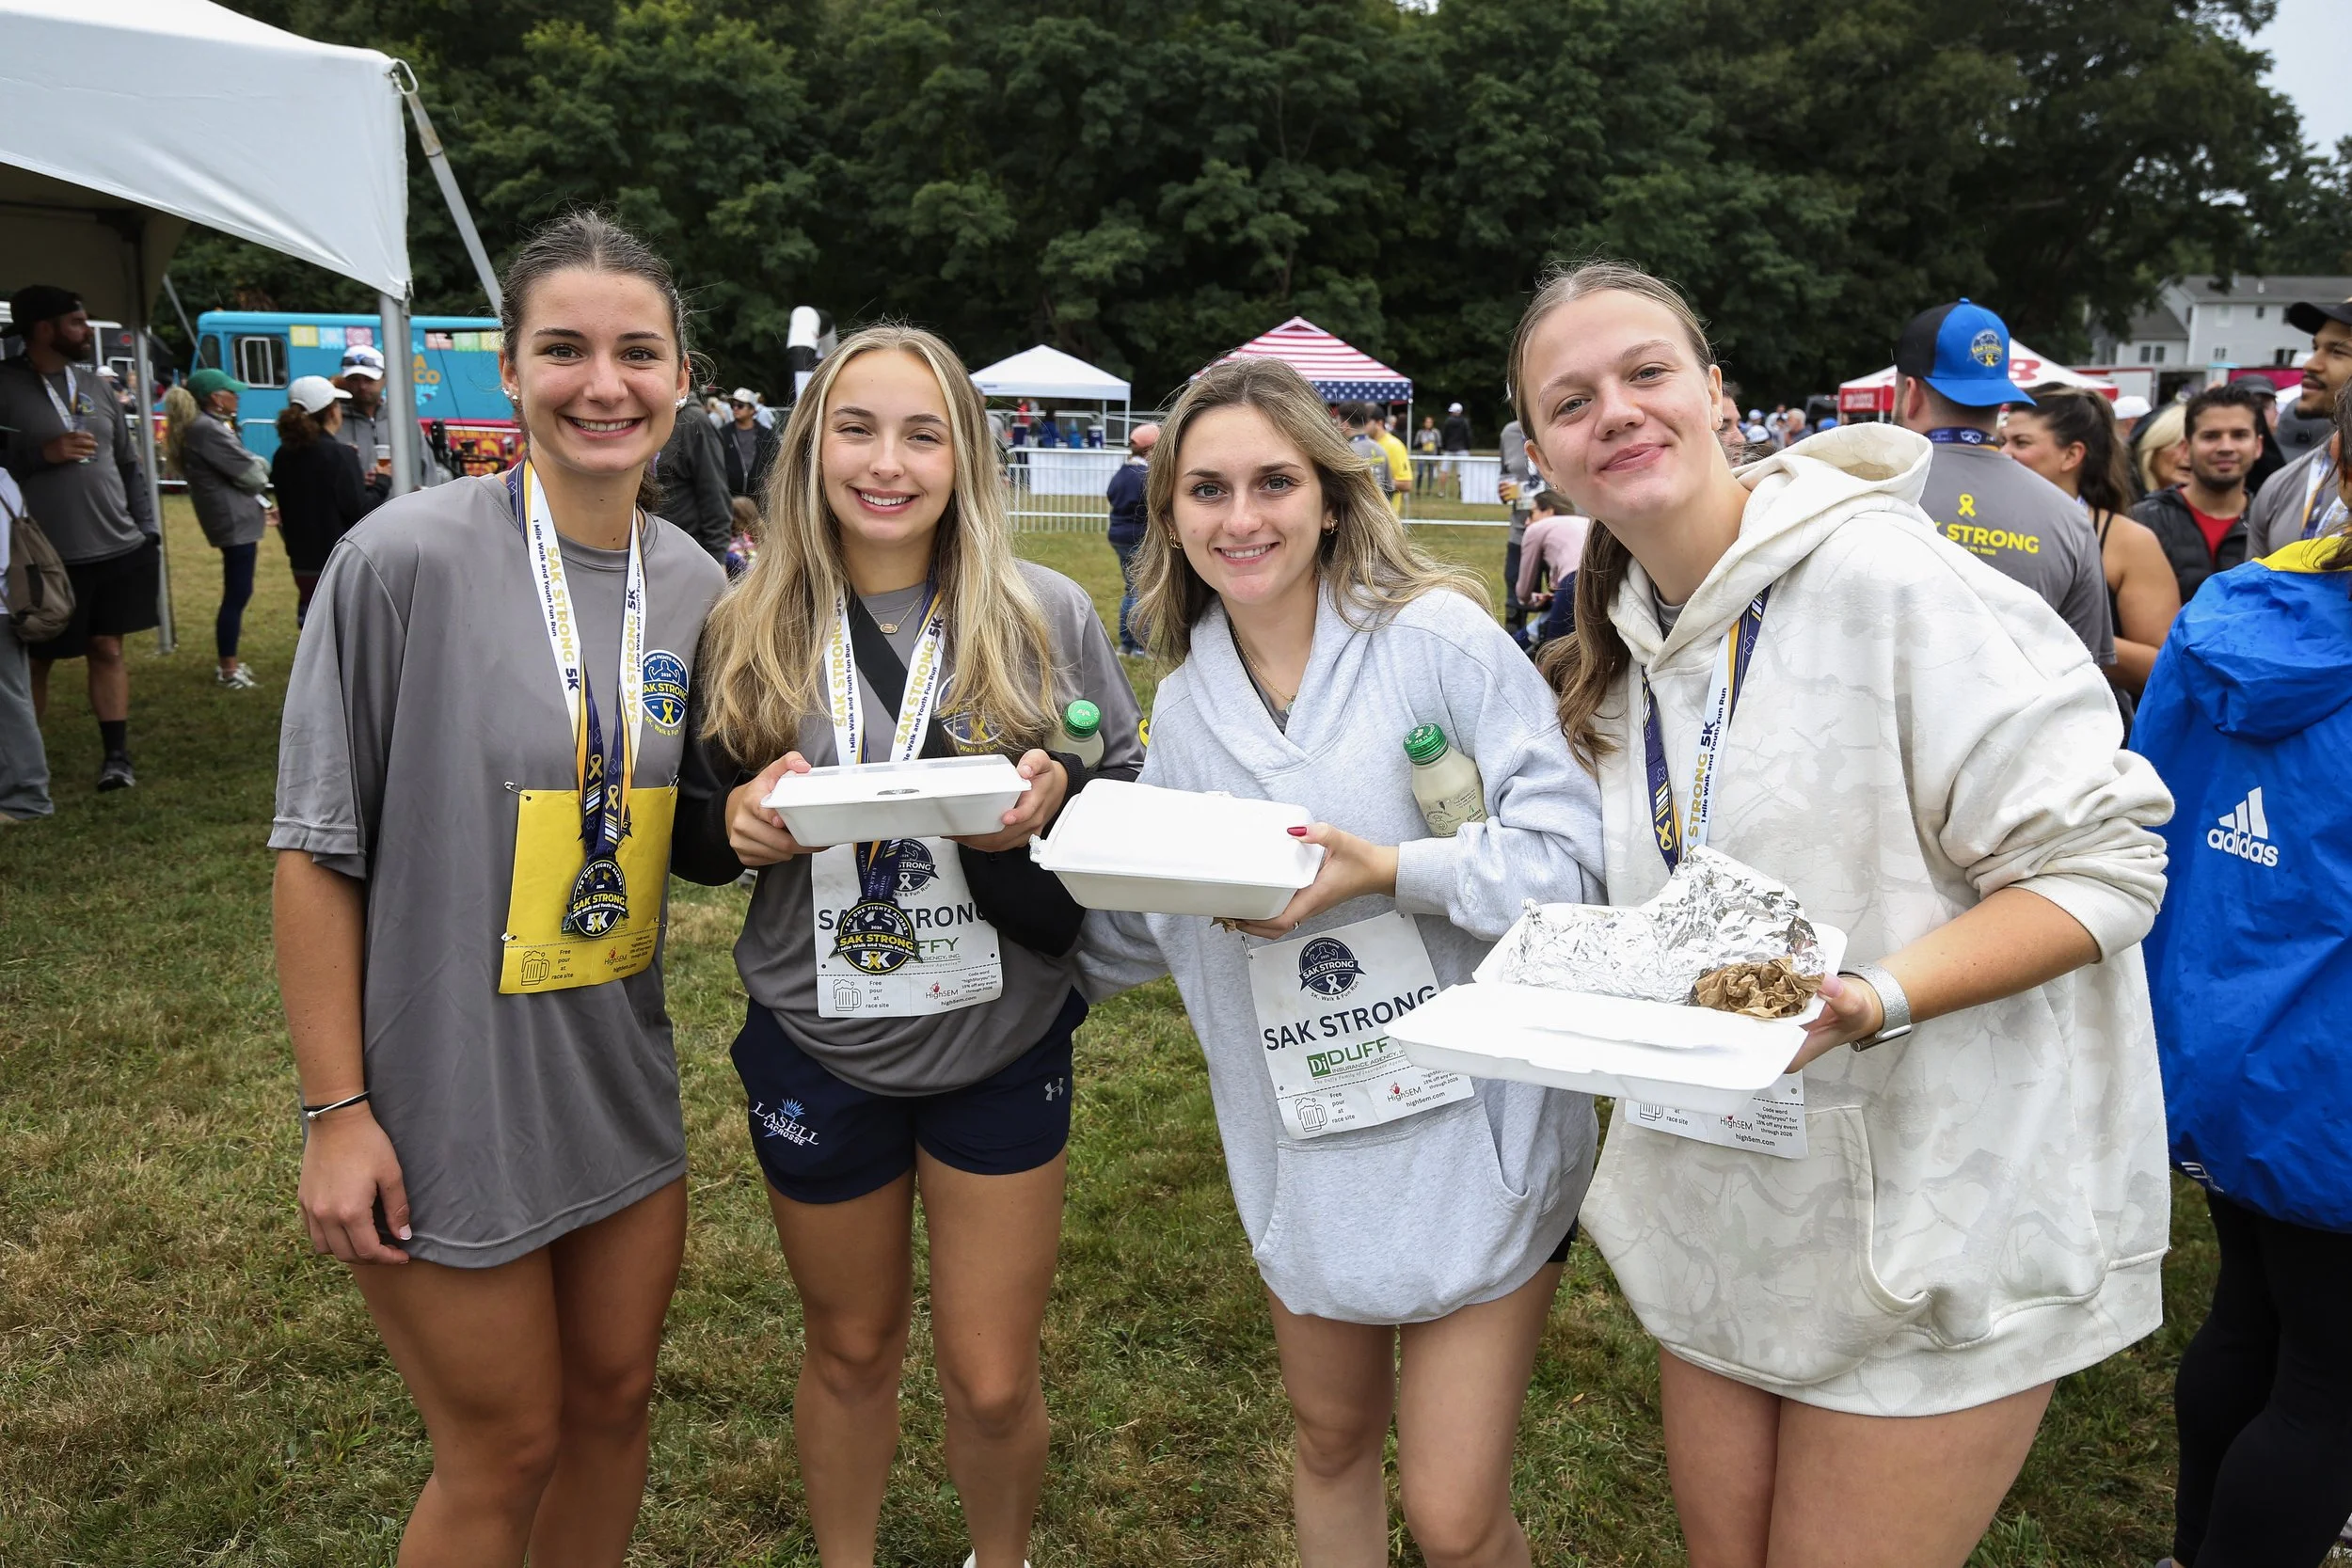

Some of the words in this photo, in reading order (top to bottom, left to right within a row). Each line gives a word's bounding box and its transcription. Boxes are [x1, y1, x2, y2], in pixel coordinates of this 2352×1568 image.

[533, 524, 542, 541] Mile
[1946, 523, 2040, 554] STRONG
[537, 542, 547, 562] Walk
[546, 546, 563, 584] SAK
[544, 579, 552, 603] Youth
[628, 587, 637, 610] 5K
[552, 589, 575, 663] STRONG
[626, 613, 637, 685] STRONG
[565, 668, 580, 691] 5K
[895, 710, 916, 746] SAK
[907, 641, 937, 708] STRONG
[928, 615, 945, 639] 5K
[929, 666, 938, 681] Run
[644, 684, 658, 694] AK
[659, 682, 688, 702] STRONG
[924, 681, 933, 695] Fun
[627, 689, 639, 724] SAK
[834, 693, 847, 727] SAK
[916, 696, 929, 716] Youth
[914, 718, 922, 732] and
[906, 734, 917, 752] Walk
[1703, 773, 1711, 797] Walk
[1710, 726, 1721, 752] Youth
[1719, 688, 1727, 705] Run
[1688, 752, 1708, 839] STRONG
[1700, 721, 1716, 748] 5K
[2206, 827, 2280, 867] adidas
[920, 882, 931, 893] Run
[572, 895, 592, 913] SAK
[592, 894, 626, 906] STRONG
[845, 918, 853, 927] NO
[852, 909, 866, 918] ONE
[866, 905, 892, 914] FIGHTS
[892, 911, 908, 931] ALONE
[839, 934, 864, 947] SAK
[866, 933, 914, 951] STRONG
[916, 936, 961, 953] FFY
[859, 950, 891, 969] 5K
[904, 948, 915, 957] Run
[1303, 967, 1320, 979] SAK
[1319, 960, 1355, 972] STRONG
[1341, 990, 1352, 999] Fun
[1351, 980, 1359, 991] Run
[1263, 1019, 1318, 1051] SAK
[1319, 985, 1438, 1038] STRONG
[1327, 1036, 1391, 1066] DUFF
[1309, 1055, 1329, 1074] Di
[1331, 1062, 1371, 1074] INSURANCE
[1370, 1052, 1399, 1066] AGENCY,
[1387, 1085, 1422, 1102] High5EM
[1429, 1081, 1448, 1090] through
[1331, 1100, 1345, 1108] pour
[1406, 1091, 1446, 1108] high5em.com
[749, 1101, 820, 1146] LASELL
[1678, 1117, 1689, 1126] site
[1720, 1117, 1754, 1132] High5EM
[762, 1119, 805, 1147] LACROSSE
[1735, 1132, 1776, 1147] high5em.com
[1760, 1128, 1780, 1136] through
